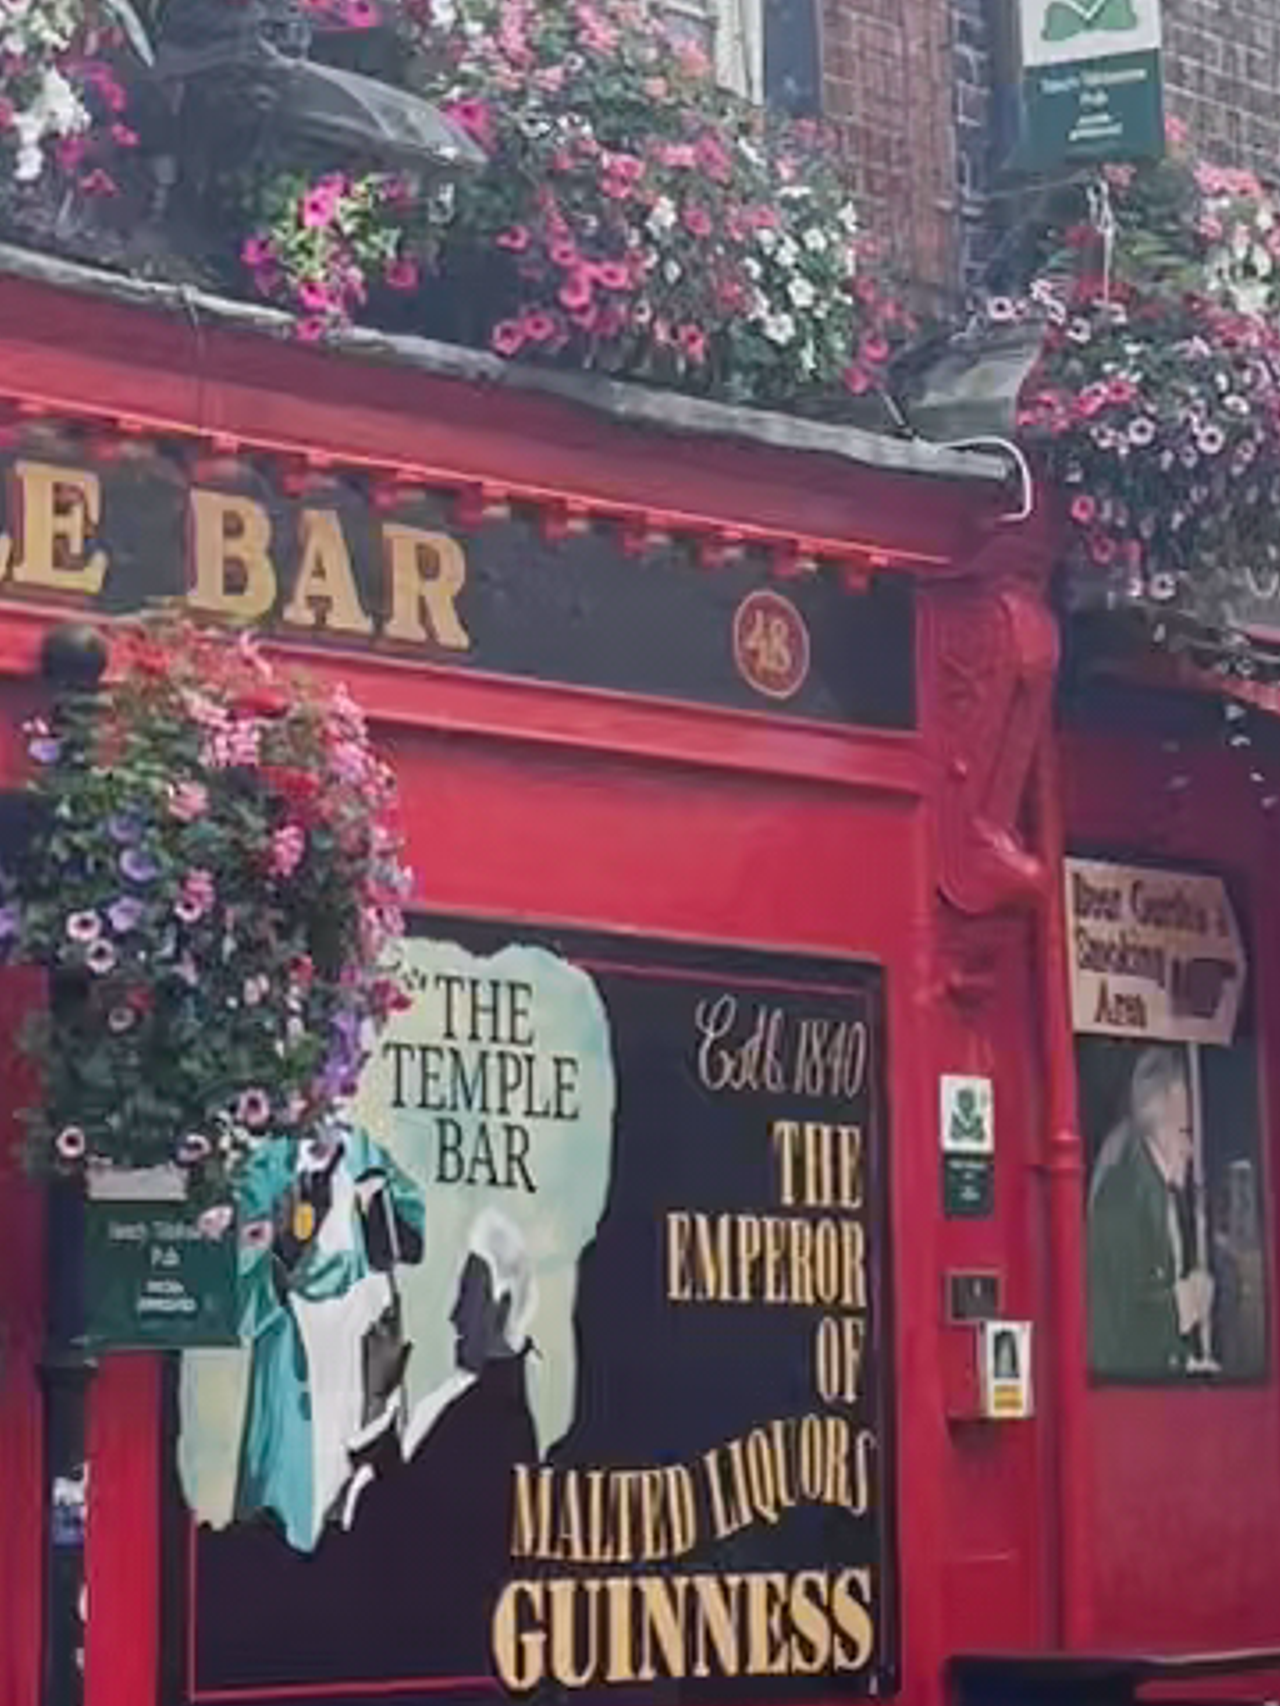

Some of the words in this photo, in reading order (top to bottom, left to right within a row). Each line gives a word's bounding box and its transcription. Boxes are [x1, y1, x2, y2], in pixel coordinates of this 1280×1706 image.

[184, 486, 472, 652] BAR
[435, 973, 535, 1048] THE
[383, 1041, 581, 1121] TEMPLE
[793, 1018, 867, 1099] 1840
[435, 1116, 537, 1195] BAR
[773, 1118, 862, 1209] THE
[666, 1211, 867, 1309] EMPEROR
[816, 1316, 865, 1404] OF
[510, 1462, 698, 1564] MALTED
[704, 1413, 877, 1541] LIQUORS
[492, 1568, 875, 1692] GUINNESS
